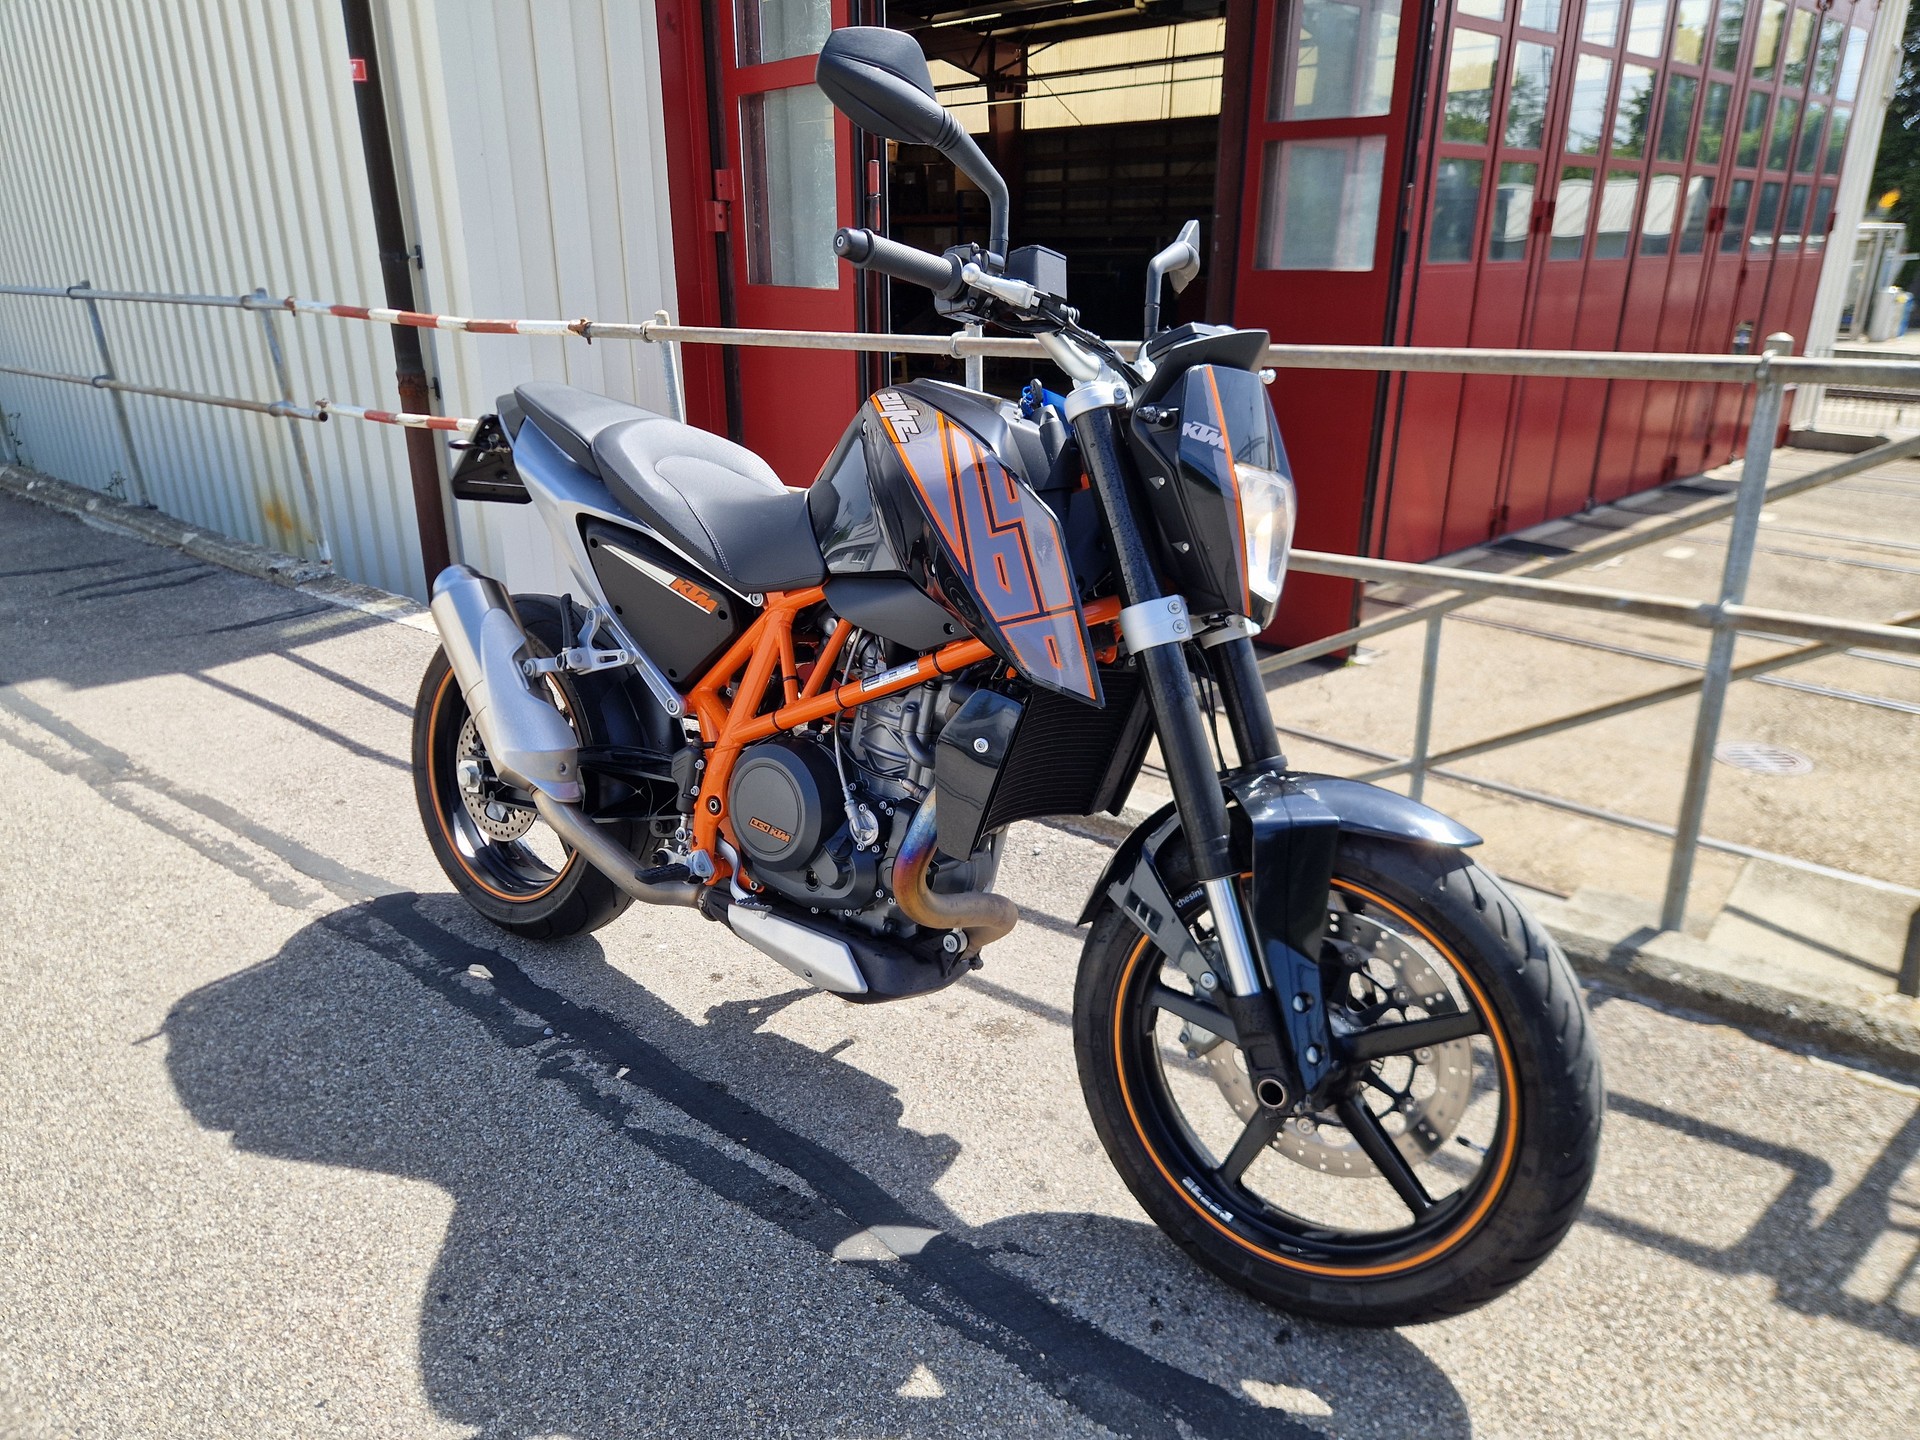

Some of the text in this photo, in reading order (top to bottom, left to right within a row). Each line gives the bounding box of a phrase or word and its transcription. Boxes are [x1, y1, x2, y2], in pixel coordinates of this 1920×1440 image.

[1182, 420, 1226, 450] KTM
[670, 578, 719, 613] KTM
[1175, 887, 1204, 908] chesini
